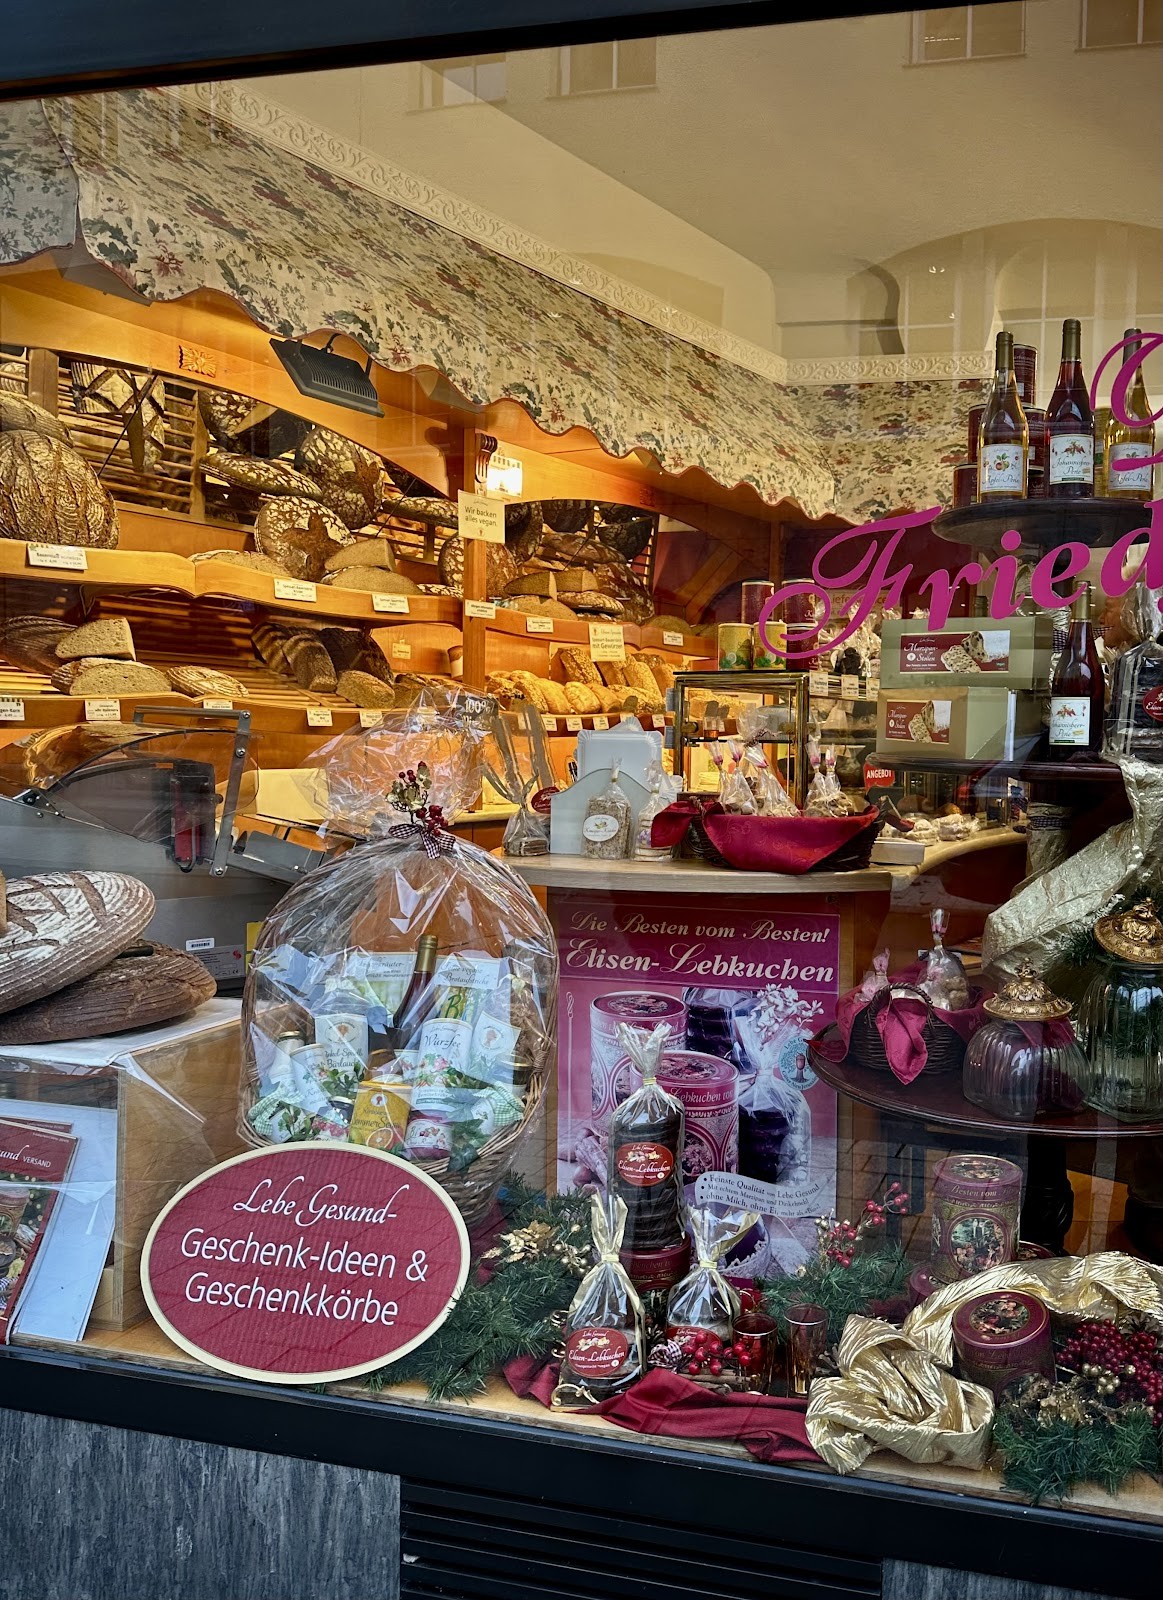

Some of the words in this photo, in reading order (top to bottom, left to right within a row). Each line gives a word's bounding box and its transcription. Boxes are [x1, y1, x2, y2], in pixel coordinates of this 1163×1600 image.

[464, 506, 475, 514] Wir
[476, 508, 497, 518] backen
[464, 515, 478, 523] alles
[570, 911, 608, 932] Die
[614, 913, 689, 936] Besten
[695, 926, 735, 938] vom
[742, 919, 831, 943] Besten!
[670, 1087, 721, 1104] Lebkuchen
[22, 1156, 51, 1168] VERSAND
[709, 1174, 735, 1186] Feinste
[736, 1180, 765, 1195] Qualität
[777, 1190, 794, 1199] Lebe
[794, 1183, 820, 1199] Gesund
[233, 1176, 305, 1216] Lebe
[294, 1184, 410, 1227] Gesund-
[706, 1191, 724, 1201] ohne
[725, 1195, 748, 1208] Milch,
[750, 1202, 768, 1213] ohne
[181, 1228, 396, 1279] Geschenk-Ideen
[405, 1250, 429, 1282] &
[185, 1272, 399, 1326] Geschenkkörbe
